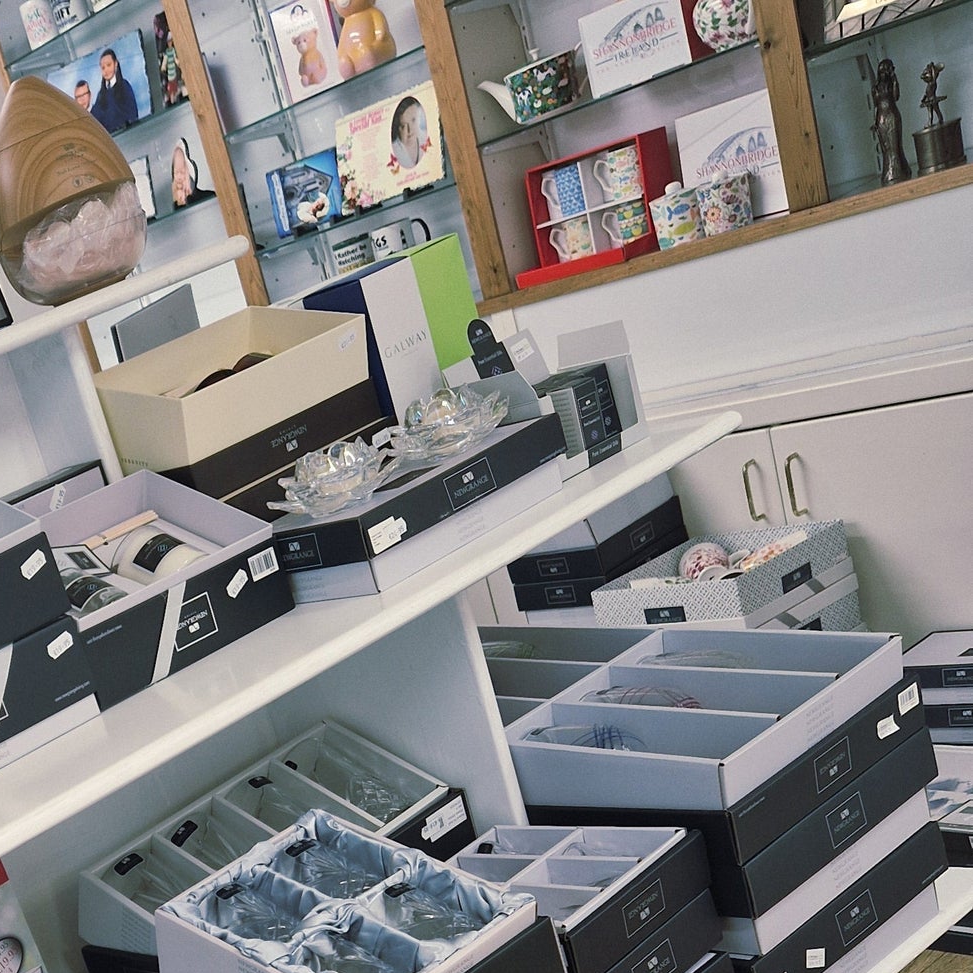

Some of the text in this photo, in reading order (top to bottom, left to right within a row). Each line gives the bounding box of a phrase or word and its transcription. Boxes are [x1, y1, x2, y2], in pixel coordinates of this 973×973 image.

[593, 18, 677, 60] SHANNONBRIDGE
[696, 146, 778, 179] SHANNONBRIDGE
[338, 246, 359, 261] Rather
[384, 329, 428, 359] GALWAY
[454, 475, 489, 499] NEWGRANGE
